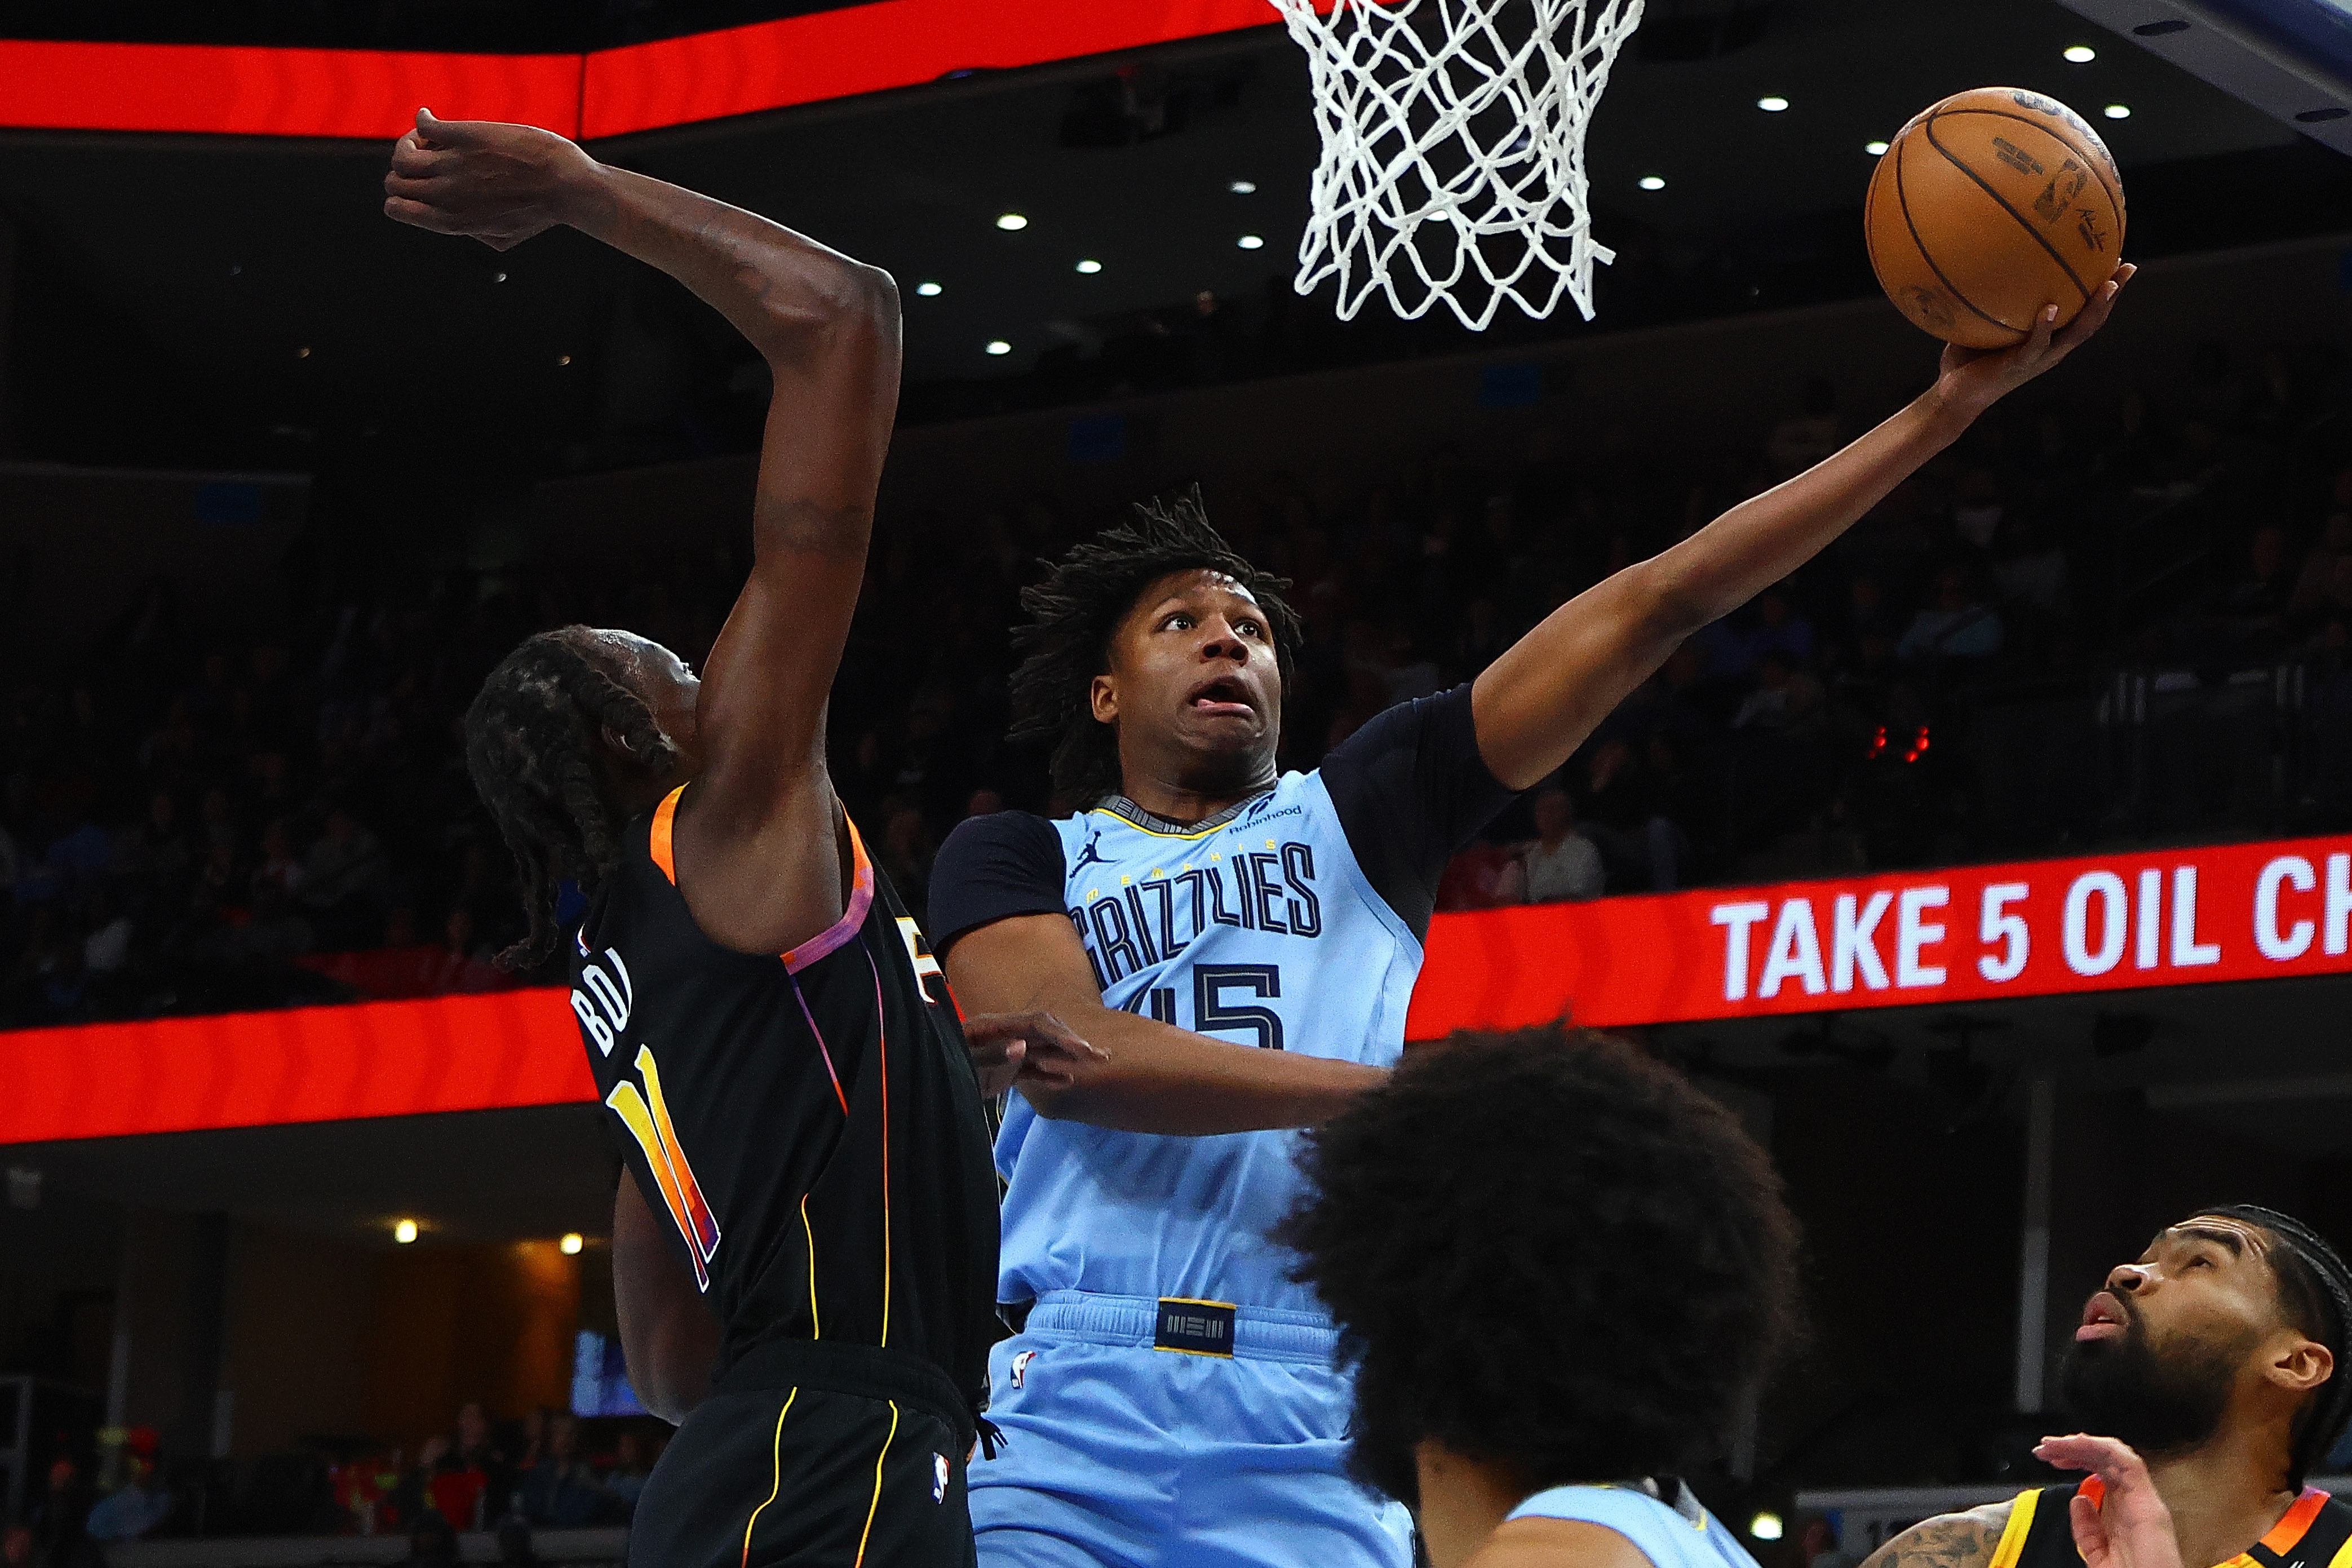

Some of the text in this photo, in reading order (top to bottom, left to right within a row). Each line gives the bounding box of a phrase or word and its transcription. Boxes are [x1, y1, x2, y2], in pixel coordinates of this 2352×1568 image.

[1711, 886, 1950, 1001] TAKE
[1978, 883, 2029, 982] 5
[2061, 866, 2221, 977] OIL
